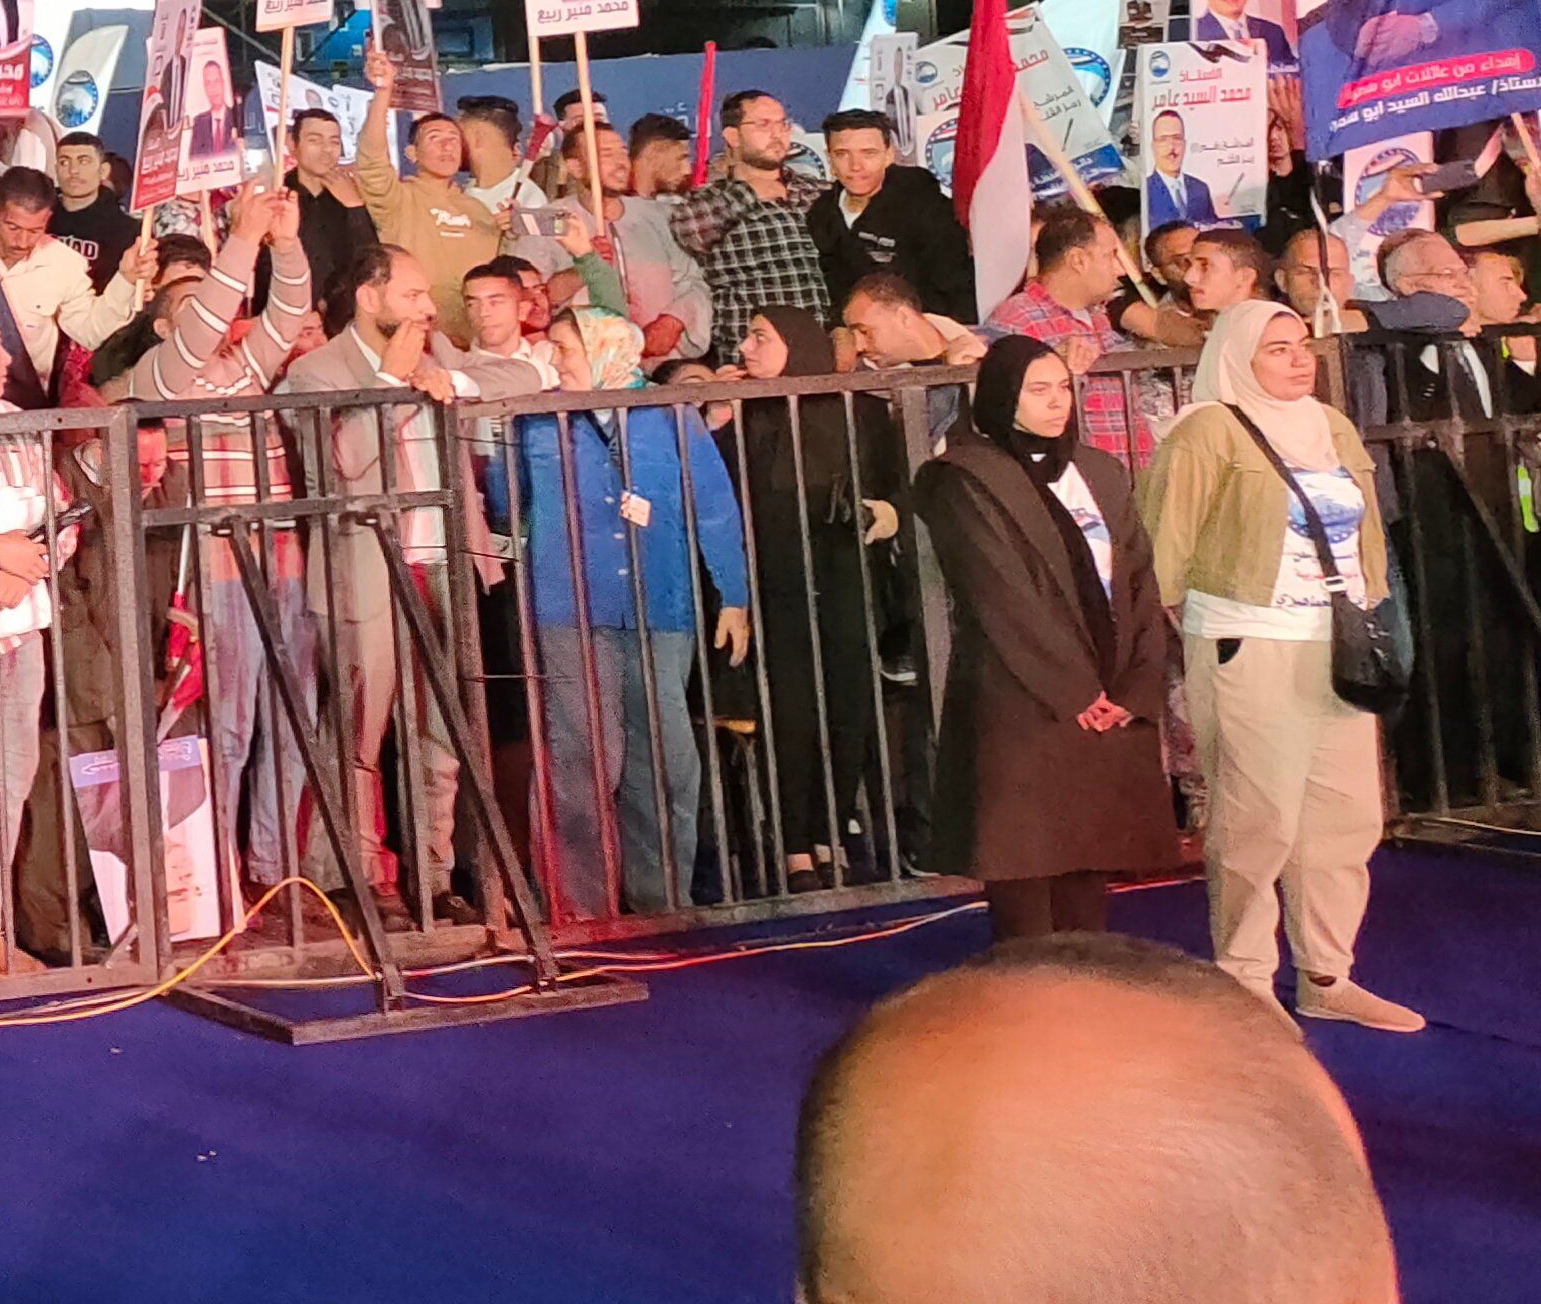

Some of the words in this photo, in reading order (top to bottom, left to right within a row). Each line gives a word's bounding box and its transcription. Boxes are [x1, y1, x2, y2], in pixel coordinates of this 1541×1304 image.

[537, 7, 562, 24] ربيع
[566, 4, 592, 22] منير
[597, 0, 628, 14] محمد
[1015, 49, 1049, 73] محم
[1453, 63, 1475, 78] من
[1151, 89, 1180, 111] عامر
[1183, 85, 1217, 111] السيد
[1220, 87, 1251, 102] محمد
[1387, 90, 1430, 114] السيد
